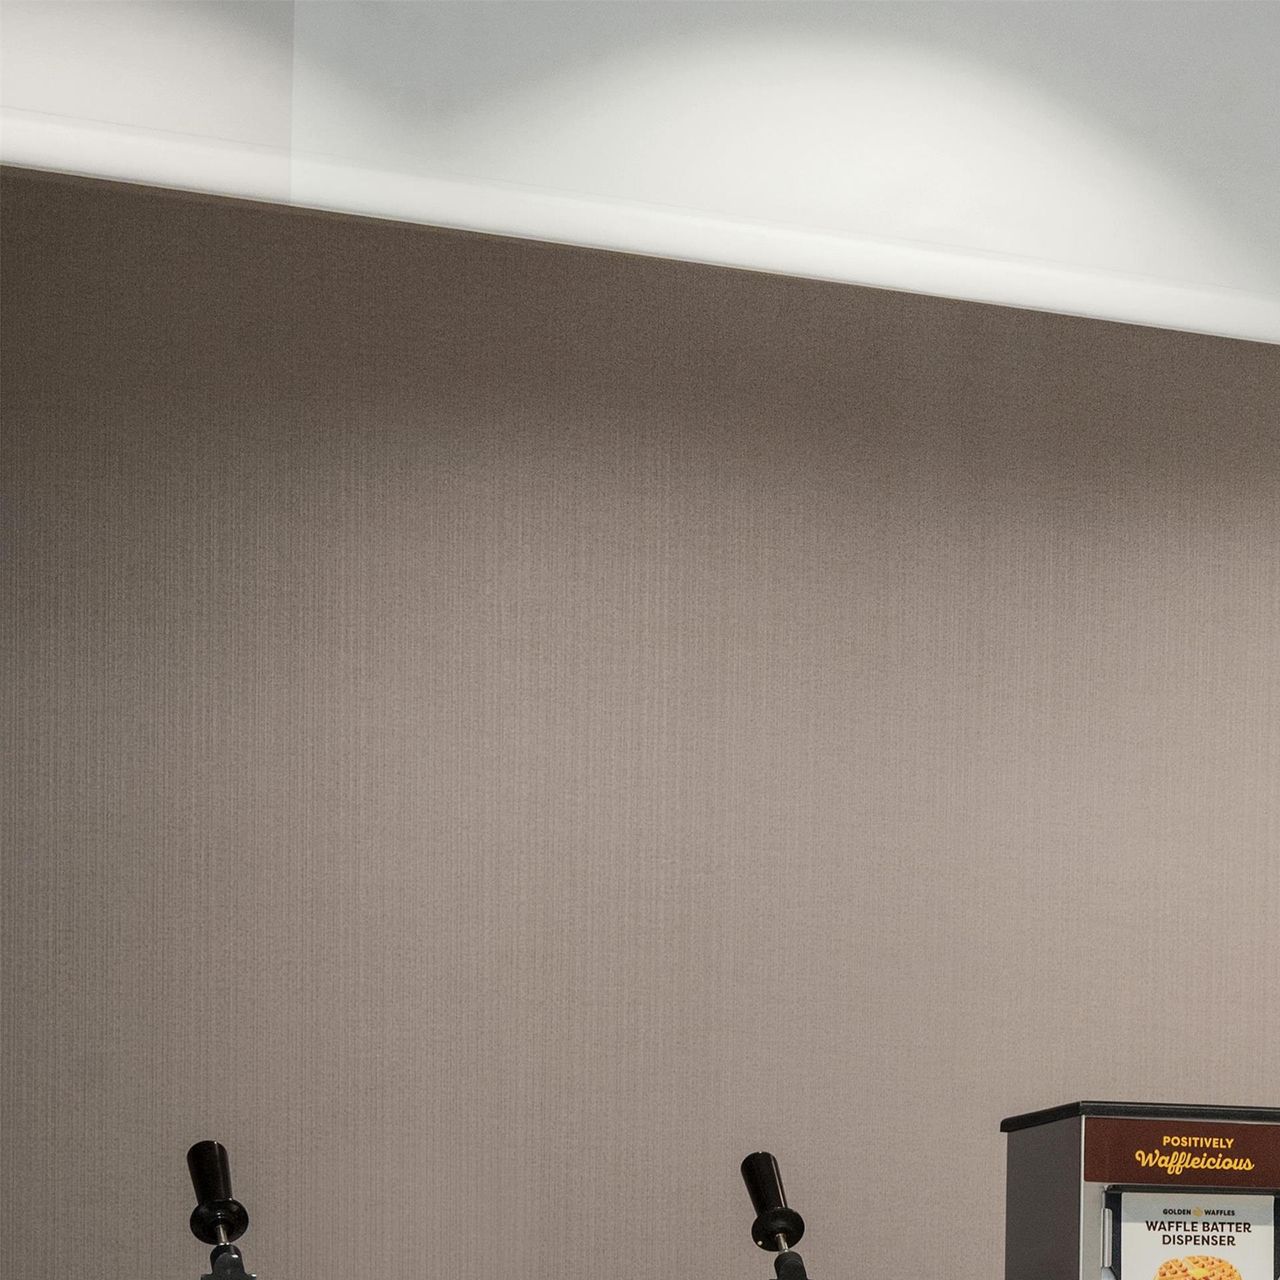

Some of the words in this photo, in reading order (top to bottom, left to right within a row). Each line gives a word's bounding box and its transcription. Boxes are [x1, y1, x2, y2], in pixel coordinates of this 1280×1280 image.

[1163, 1135, 1234, 1148] POSITIVELY
[1135, 1149, 1255, 1175] Waffleicious
[1146, 1220, 1198, 1232] WAFFLE
[1202, 1222, 1252, 1233] BATTER
[1162, 1234, 1236, 1246] DISPENSER
